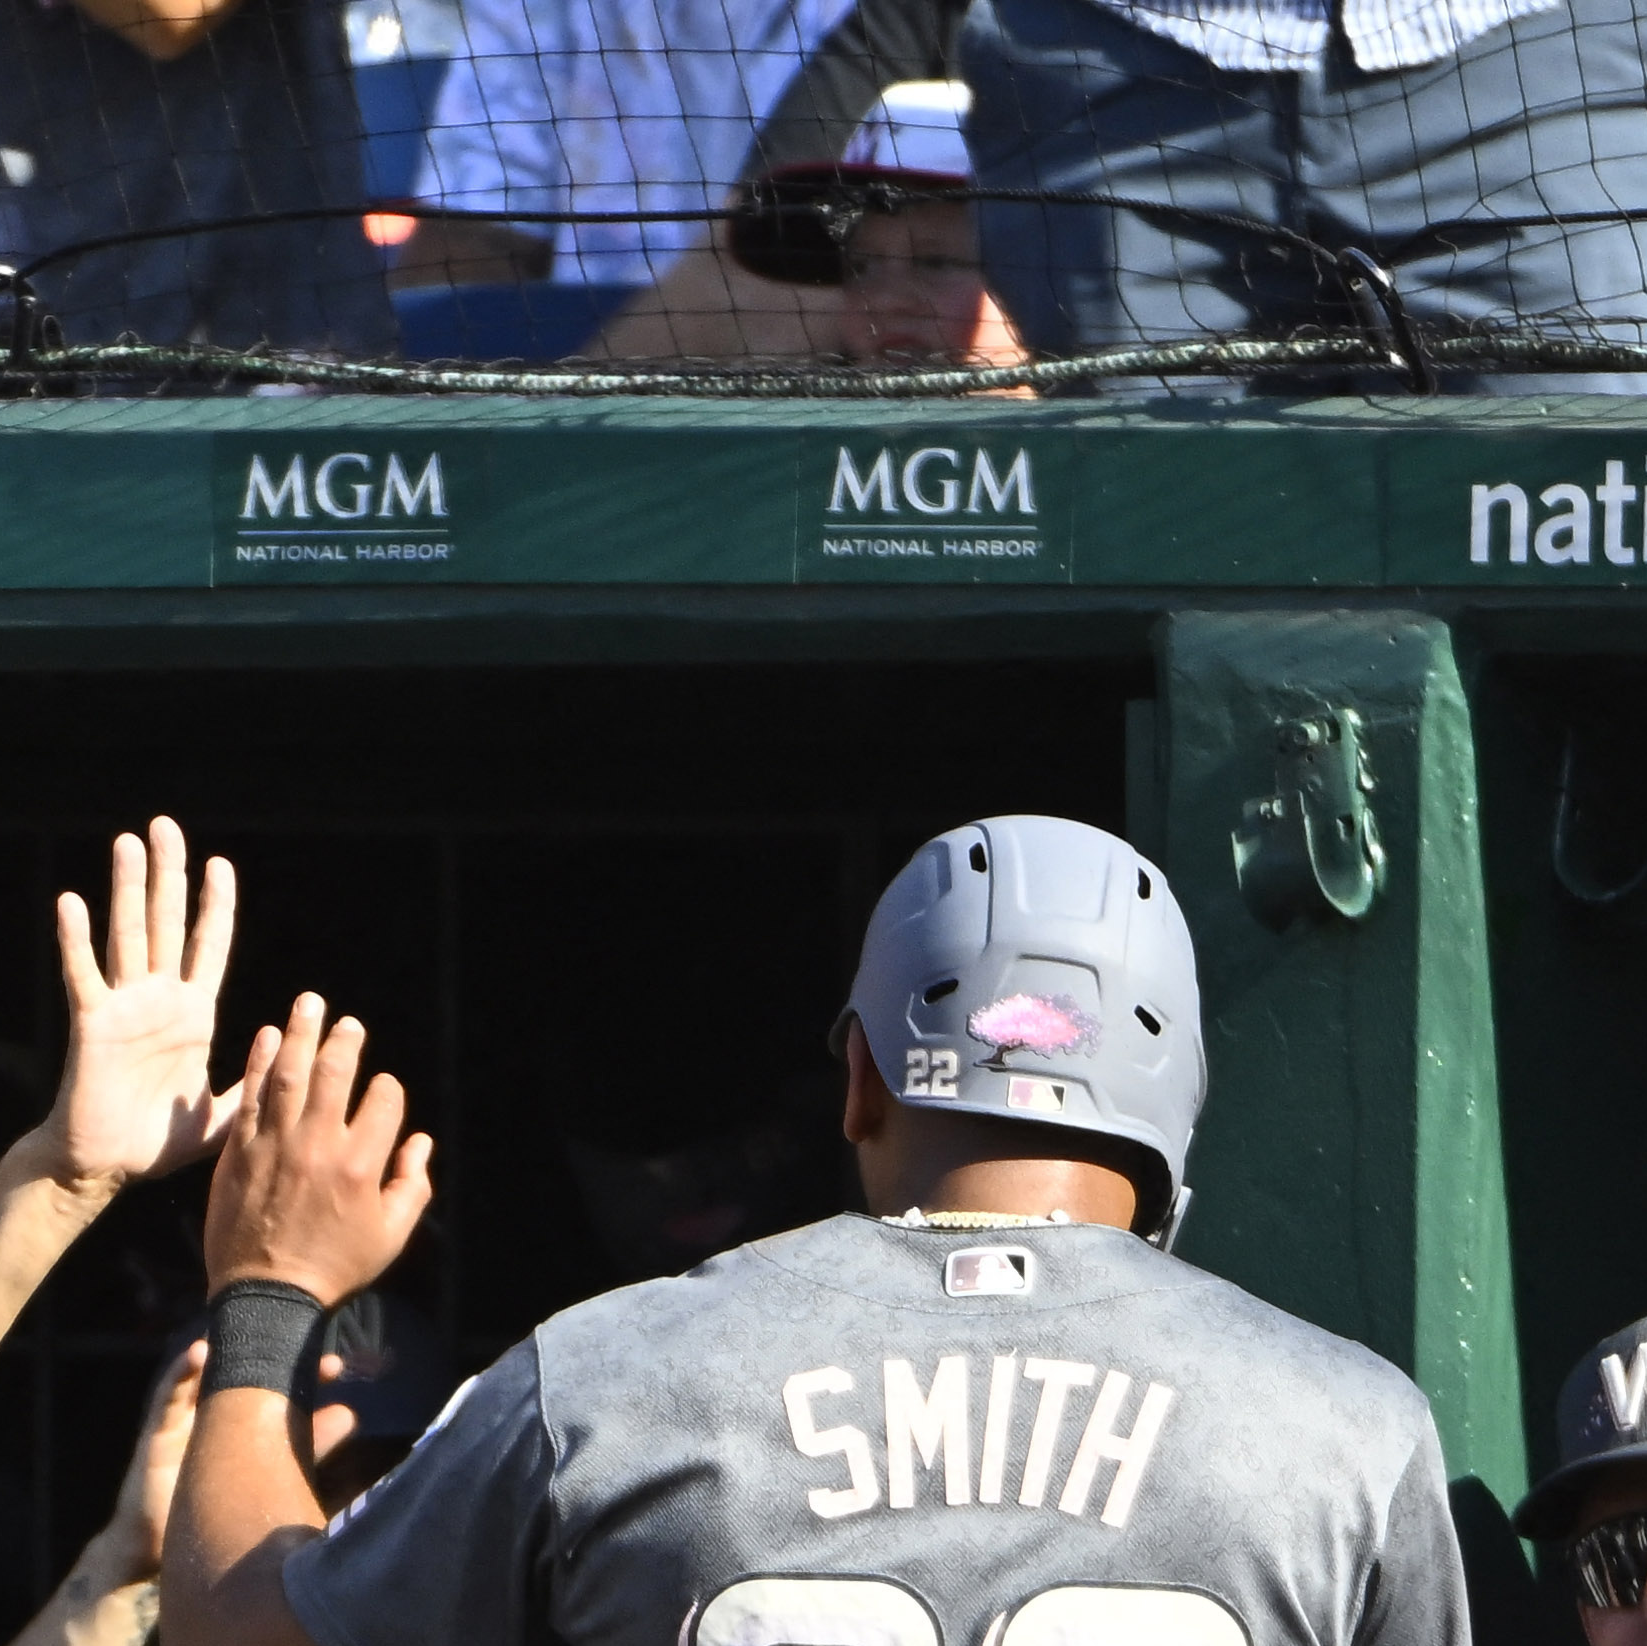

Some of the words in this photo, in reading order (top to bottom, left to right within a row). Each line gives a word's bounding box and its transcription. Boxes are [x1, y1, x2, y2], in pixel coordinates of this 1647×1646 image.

[238, 452, 449, 519] MGM
[824, 446, 1038, 514] MGM
[235, 545, 349, 562] NATIONAL
[355, 543, 450, 562] HARBOR
[822, 538, 935, 557] NATIONAL
[942, 538, 1038, 557] HARBOR
[905, 1048, 961, 1100] 22
[782, 1355, 1174, 1529] SMITH
